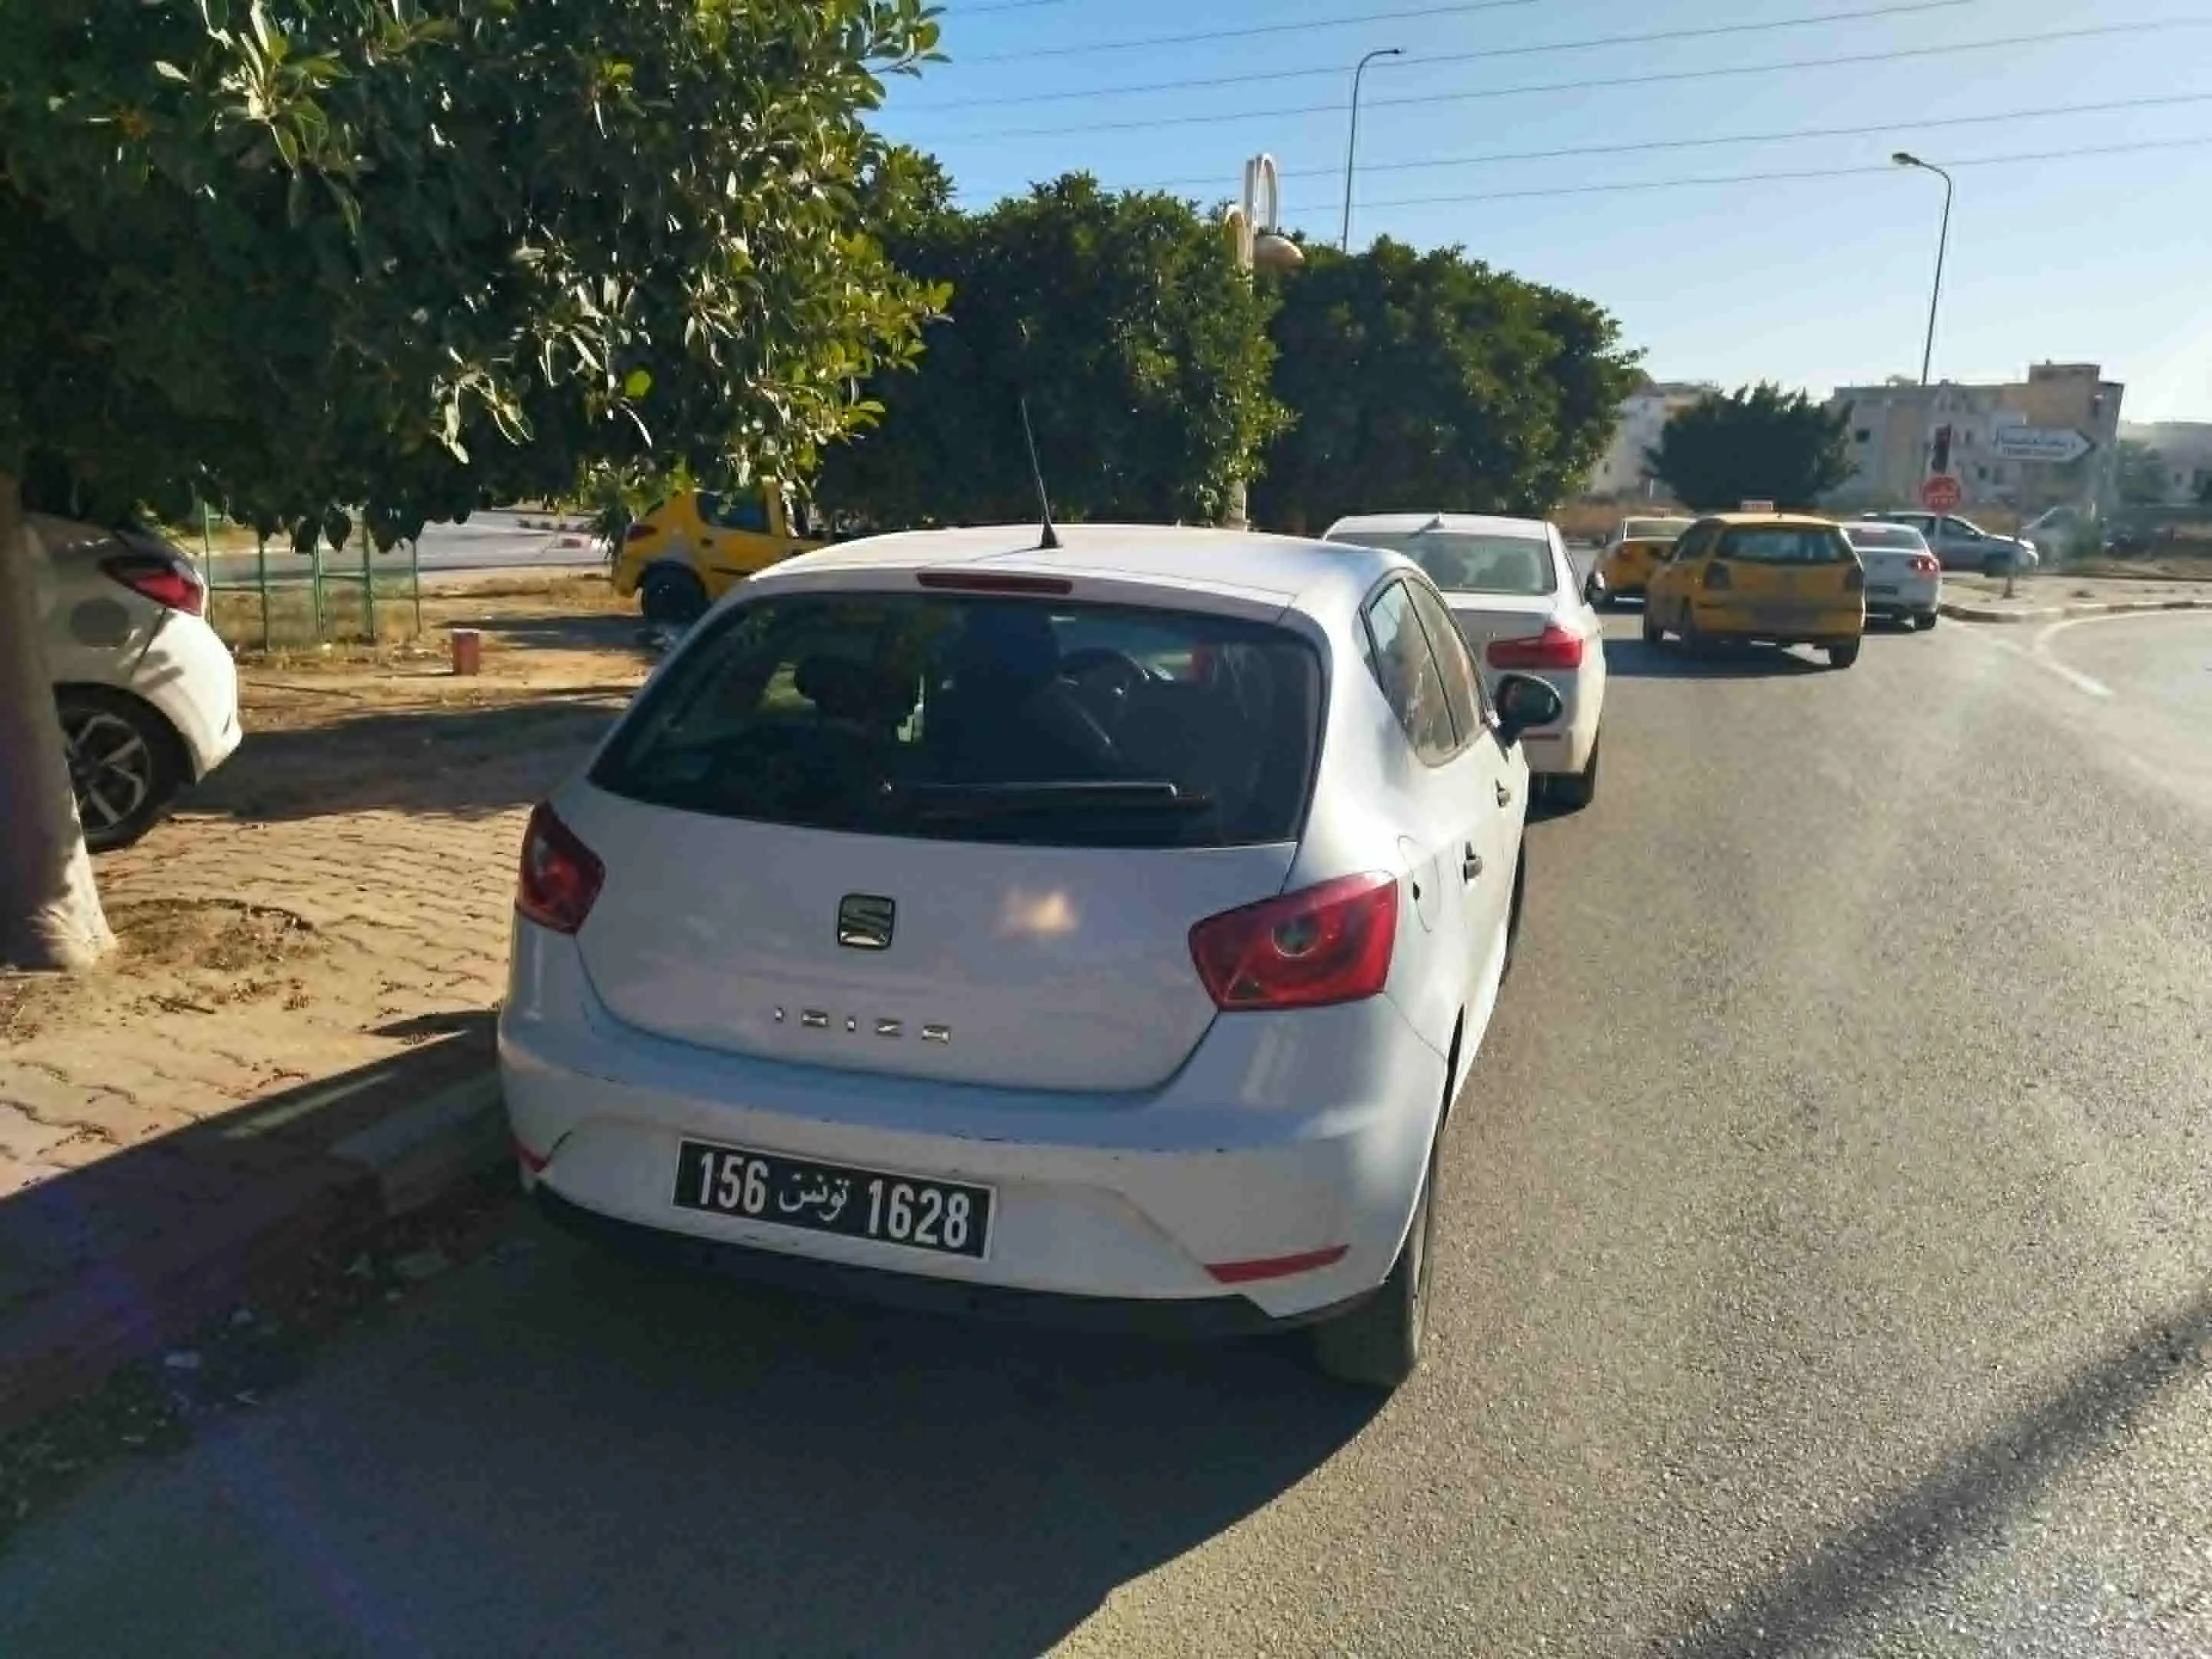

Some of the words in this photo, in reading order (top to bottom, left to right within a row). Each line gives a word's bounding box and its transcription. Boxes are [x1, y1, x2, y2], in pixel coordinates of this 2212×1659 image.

[774, 1006, 951, 1045] IBIZA
[700, 1151, 768, 1214] 156
[778, 1172, 849, 1222] تونس
[868, 1179, 969, 1248] 1628
